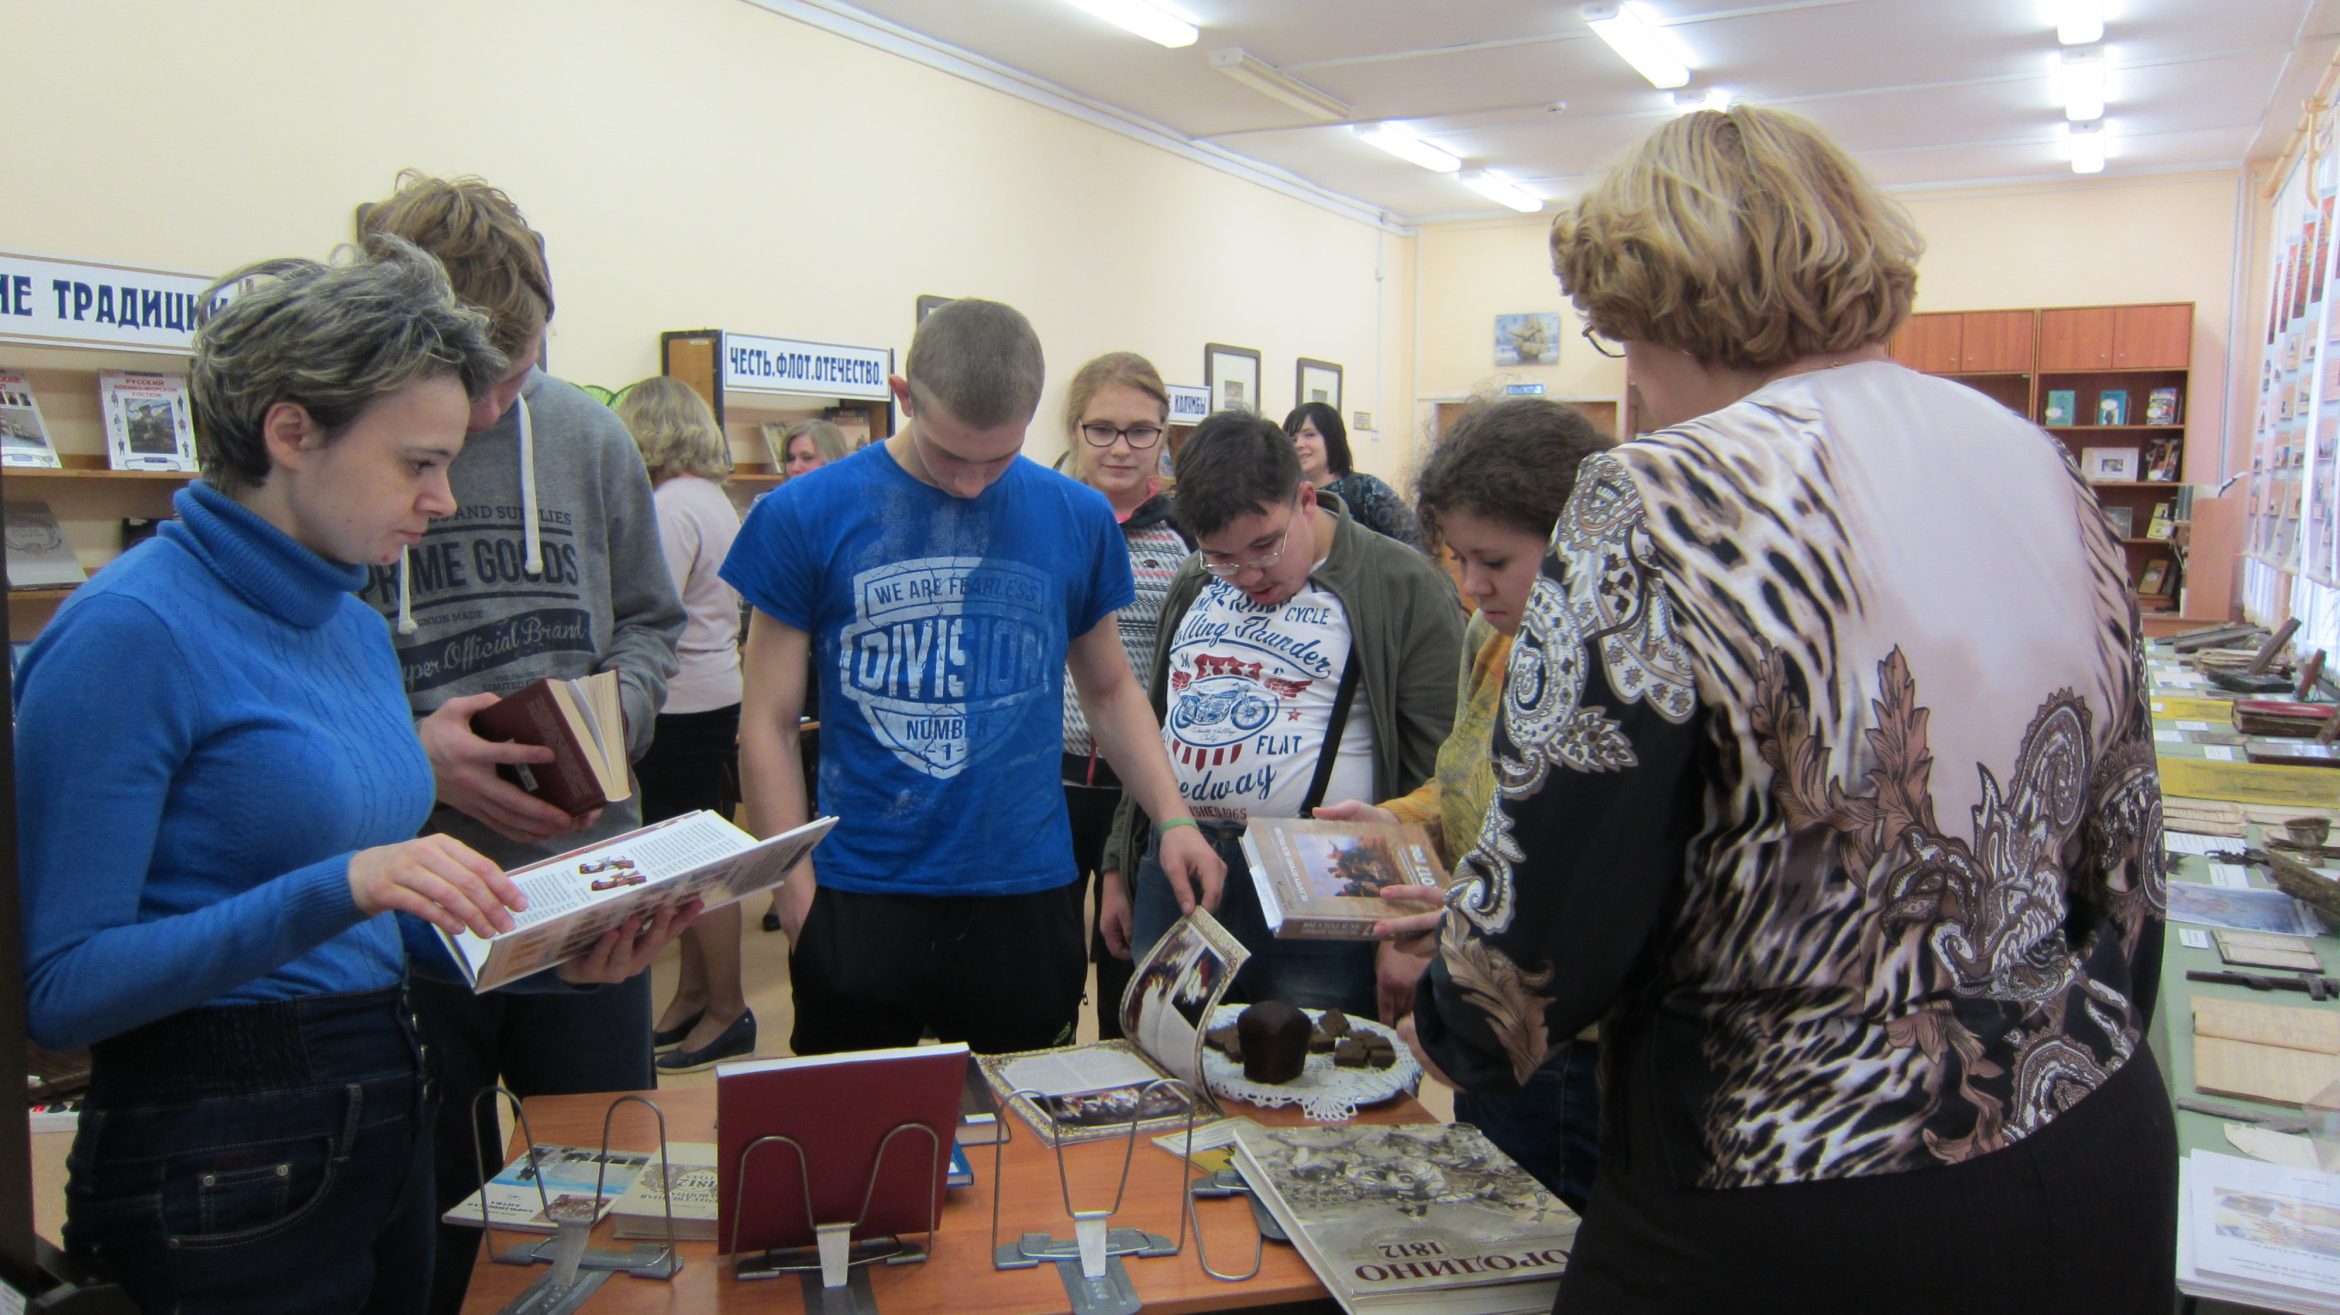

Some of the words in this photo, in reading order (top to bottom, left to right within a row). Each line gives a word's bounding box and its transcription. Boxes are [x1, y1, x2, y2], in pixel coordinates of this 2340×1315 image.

[454, 505, 492, 520] AND
[496, 504, 572, 525] SULIES
[365, 542, 467, 604] RME
[874, 583, 907, 605] WE
[909, 579, 942, 599] ARE
[949, 577, 1037, 602] FEARLESS
[1285, 606, 1331, 625] CYCLE
[443, 621, 520, 671] Official
[858, 617, 1049, 699] DIVISION
[1235, 615, 1332, 675] Thunder
[906, 718, 988, 741] NUMBER
[1256, 735, 1302, 755] FLAT
[1176, 763, 1278, 801] edway
[1378, 1241, 1443, 1259] 1812
